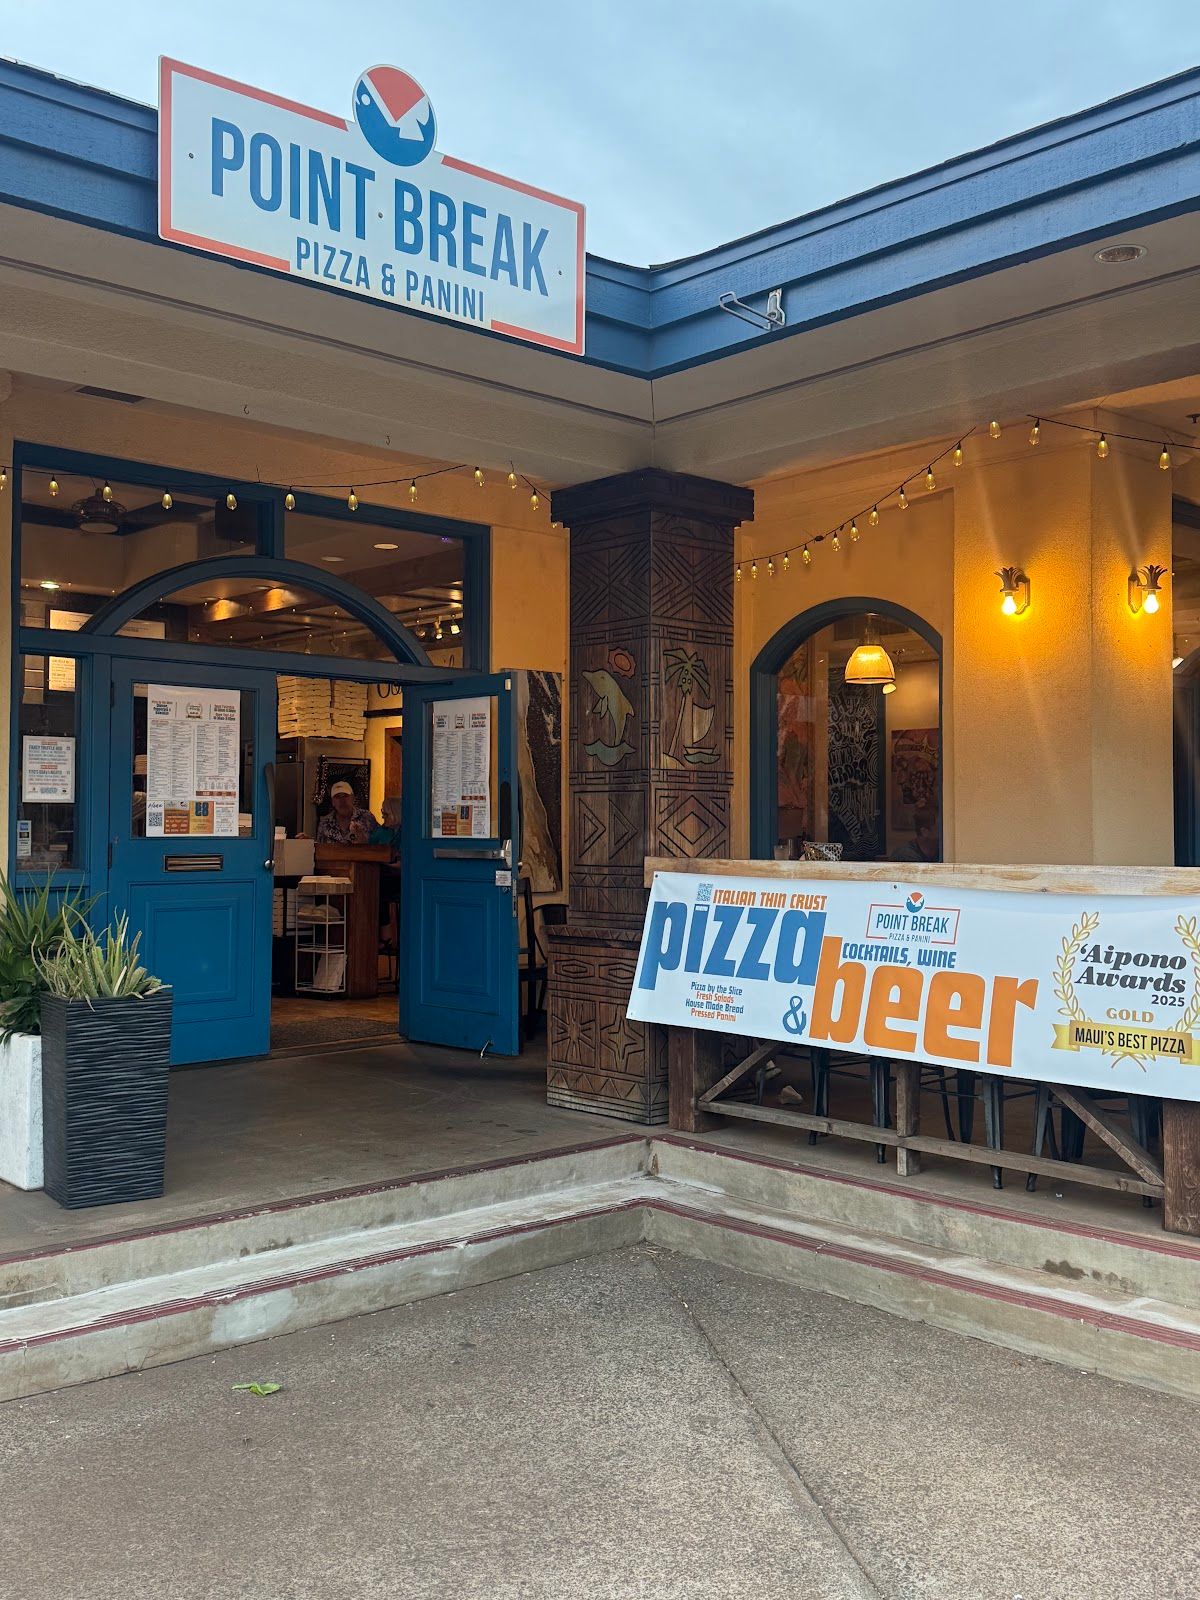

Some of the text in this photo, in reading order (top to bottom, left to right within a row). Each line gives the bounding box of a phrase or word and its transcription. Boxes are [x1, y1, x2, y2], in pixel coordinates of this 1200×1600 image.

[211, 117, 549, 297] POINT BREAK
[296, 236, 484, 322] PIZZA & PANINI
[713, 889, 827, 911] ITALIAN THIN CRUST
[876, 913, 950, 933] POINT BREAK
[638, 901, 827, 990] pizza
[888, 932, 905, 941] PIZZA
[912, 935, 931, 944] PANINI
[842, 942, 957, 969] COCKTAILS, WINE
[690, 982, 742, 996] Pizza by the Slice
[1074, 966, 1186, 994] Awards
[685, 998, 744, 1014] House Made Bread
[696, 991, 734, 1003] Fresh Salads
[809, 936, 1039, 1067] beer
[1151, 994, 1185, 1007] 2025
[691, 1008, 736, 1022] Pressed Panini
[782, 996, 807, 1035] &
[1106, 1007, 1154, 1023] GOLD
[1118, 1032, 1148, 1050] BEST
[1150, 1036, 1186, 1054] PIZZA
